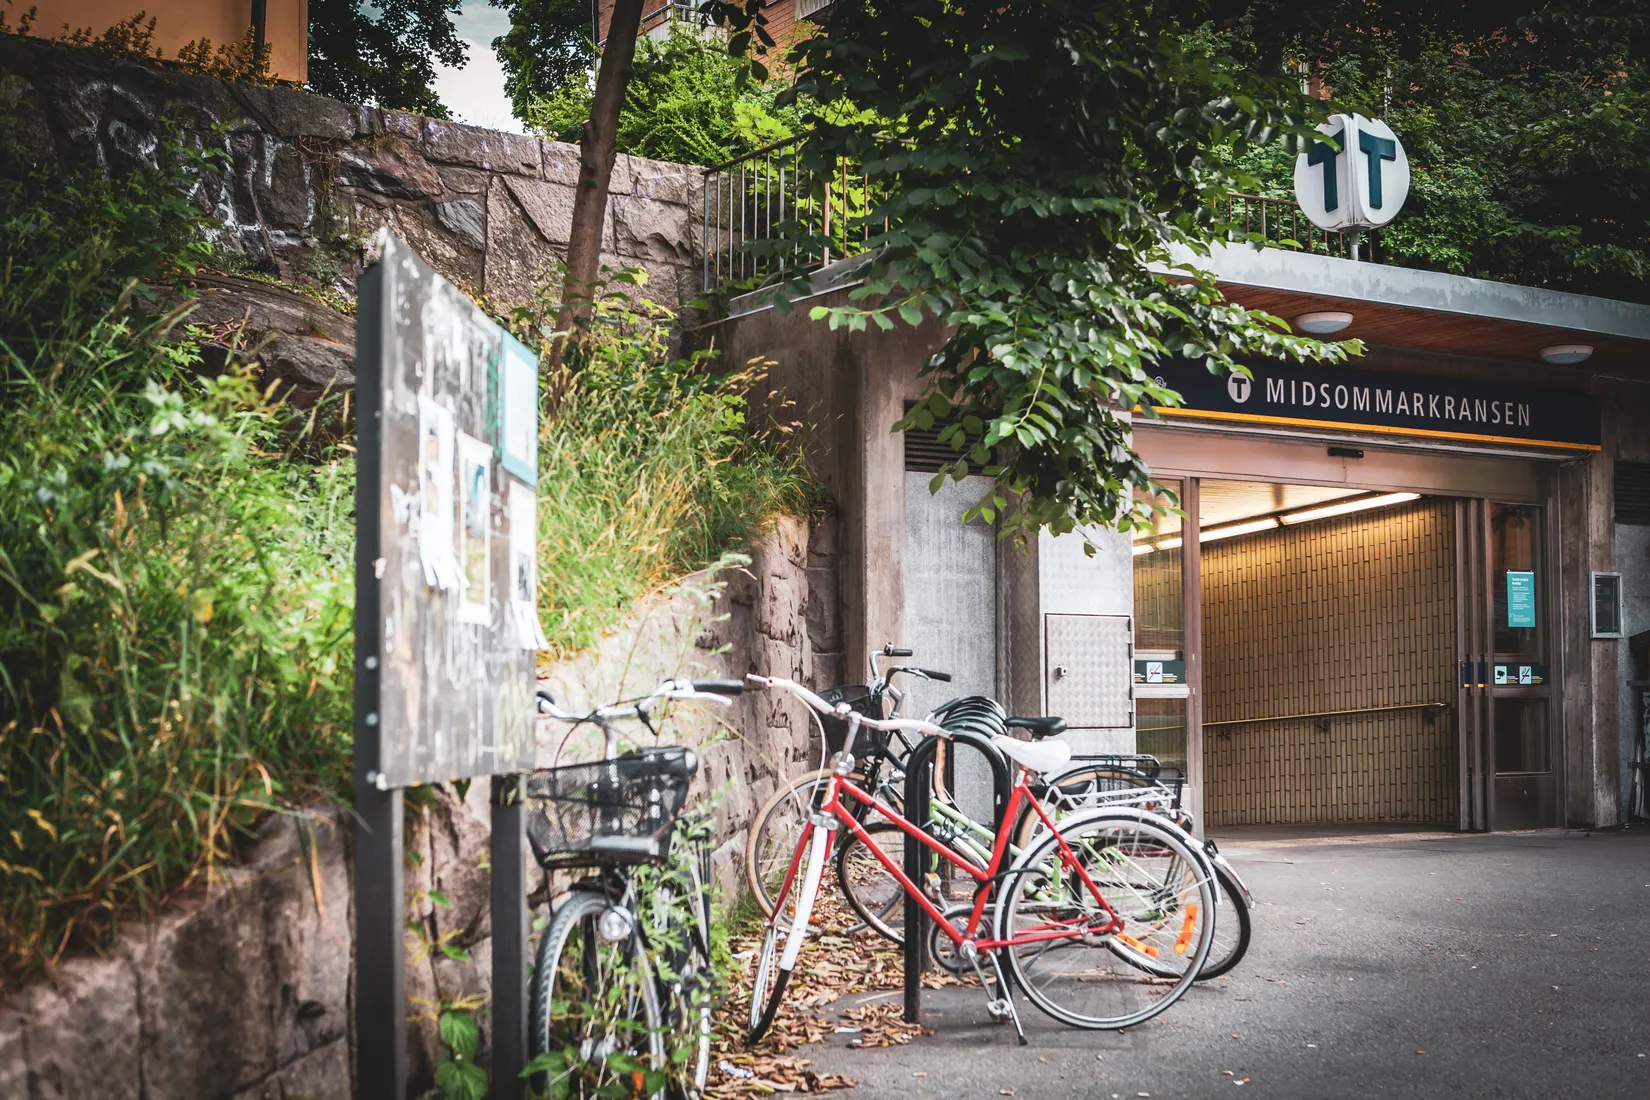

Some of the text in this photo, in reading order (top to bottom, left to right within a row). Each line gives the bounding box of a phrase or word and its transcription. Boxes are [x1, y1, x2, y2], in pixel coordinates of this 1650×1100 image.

[1307, 128, 1345, 213] T
[1358, 128, 1397, 210] T
[1231, 376, 1530, 426] T MIDSOMMARKRANSEN
